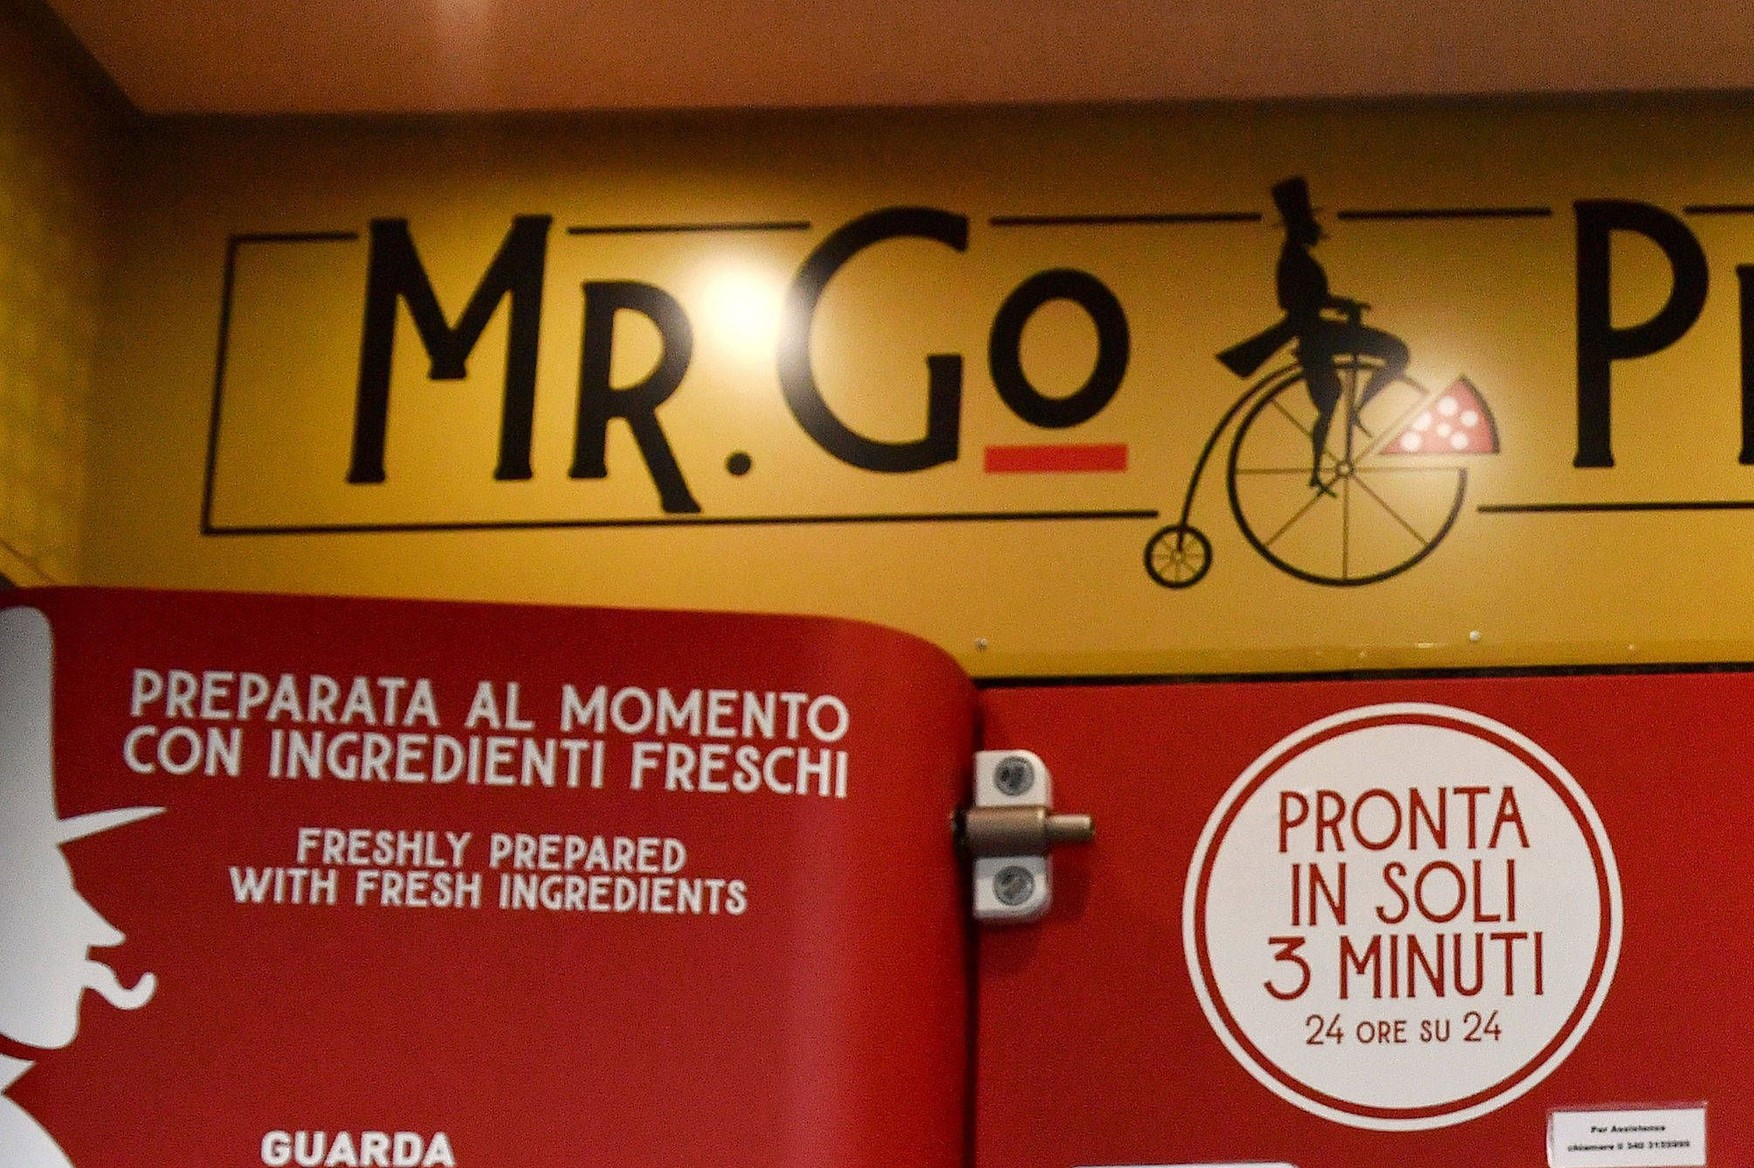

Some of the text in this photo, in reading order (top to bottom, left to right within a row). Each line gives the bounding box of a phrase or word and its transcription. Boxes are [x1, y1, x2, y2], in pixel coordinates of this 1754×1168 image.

[131, 669, 850, 743] PREPARATA AL MOMENTO
[124, 725, 848, 799] CON INGREDIENTI FRESCHI
[297, 827, 687, 874] FRESHLY PREPARED
[1279, 786, 1530, 854] PRONTA
[229, 866, 747, 915] WITH FRESH INGREDIENTS
[1291, 858, 1516, 927] IN SOLI
[1263, 931, 1544, 1001] 3 MINUTI
[1305, 1010, 1502, 1046] 24 ORE SU 24
[261, 1130, 456, 1168] GUARDA
